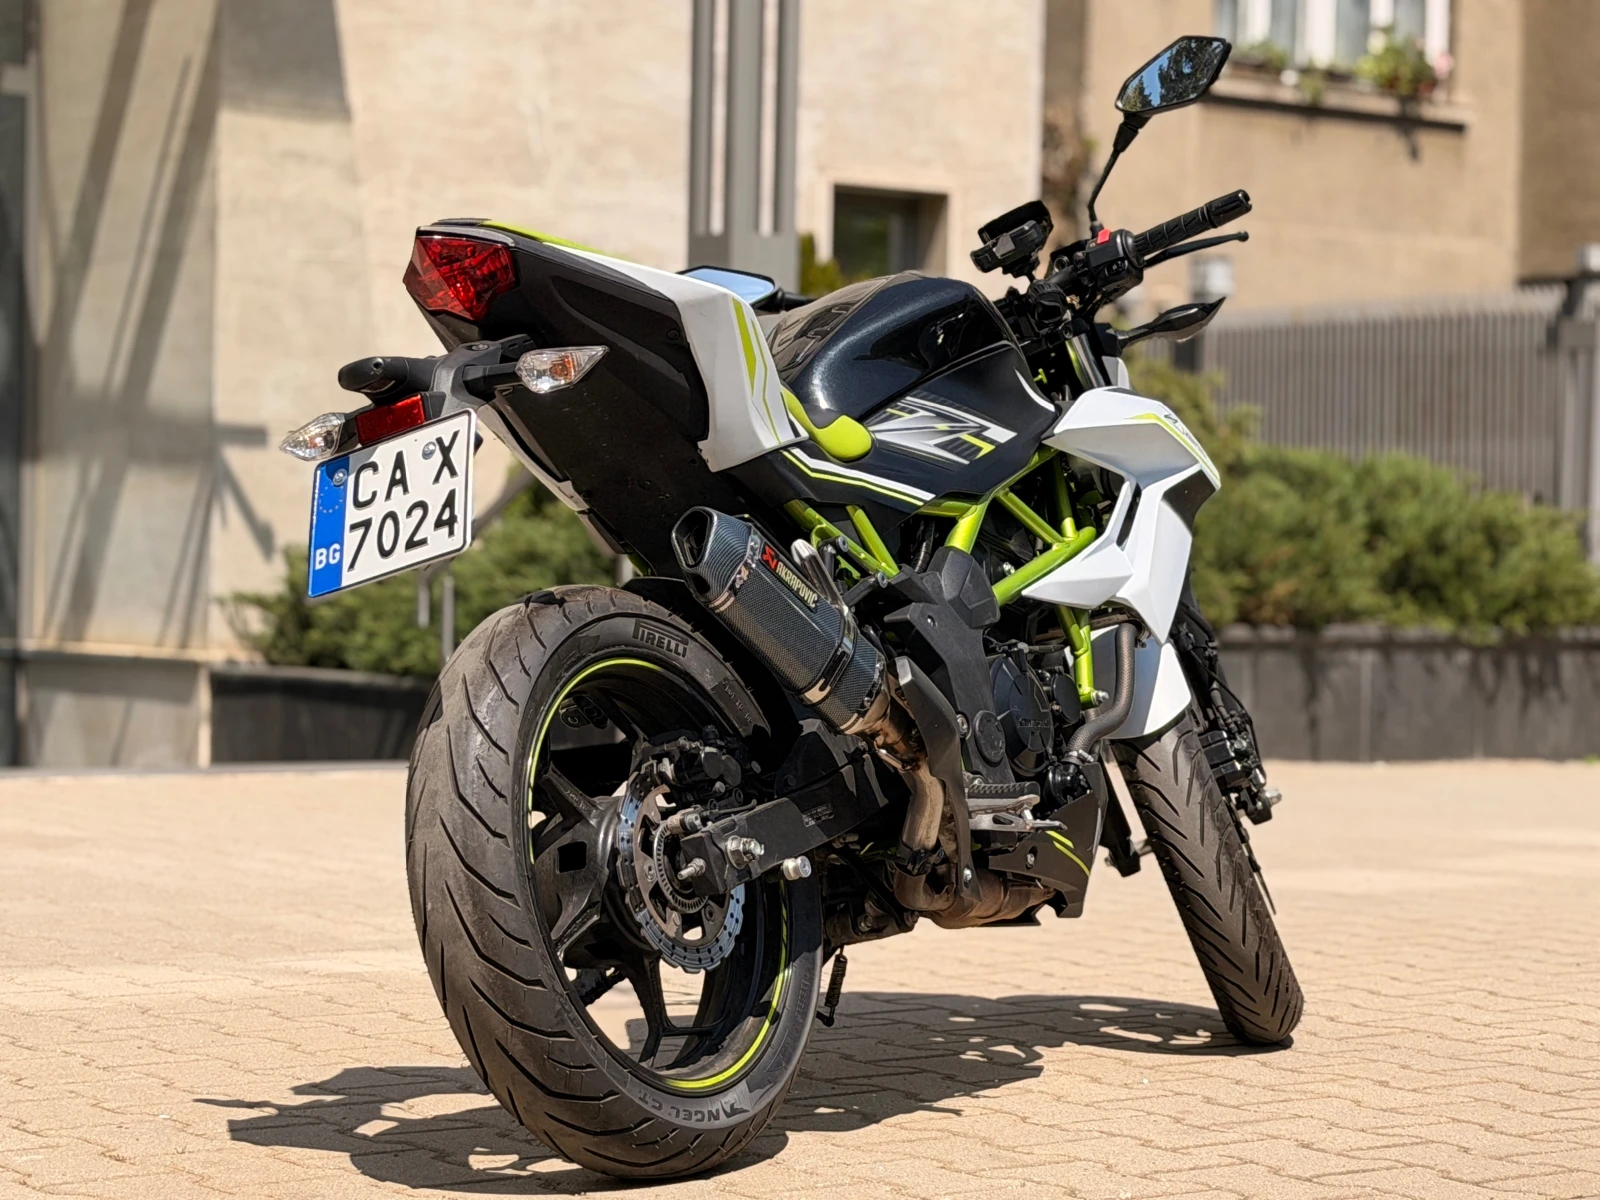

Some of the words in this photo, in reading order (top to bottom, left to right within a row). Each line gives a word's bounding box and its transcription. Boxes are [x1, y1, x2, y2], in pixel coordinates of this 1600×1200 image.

[353, 450, 410, 510] CA
[432, 430, 460, 485] X
[315, 543, 341, 570] BG
[347, 488, 458, 572] 7024
[632, 619, 689, 658] PIRELLI
